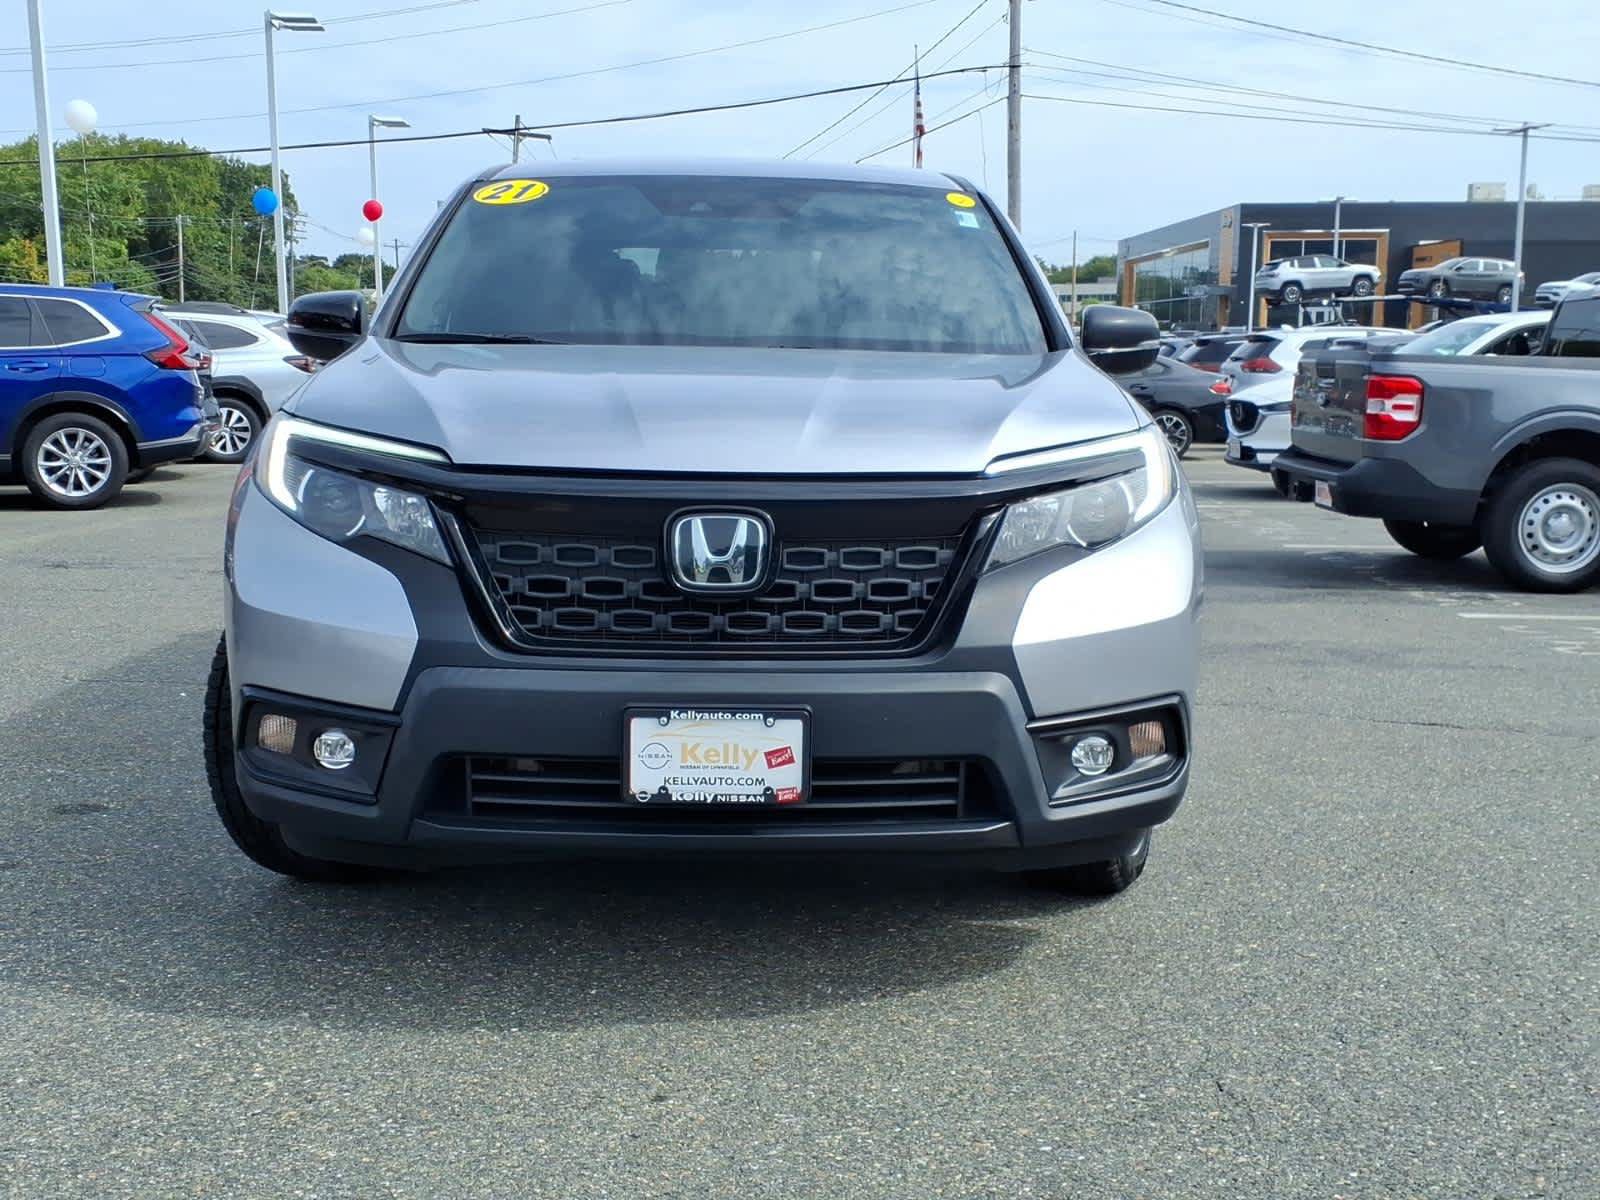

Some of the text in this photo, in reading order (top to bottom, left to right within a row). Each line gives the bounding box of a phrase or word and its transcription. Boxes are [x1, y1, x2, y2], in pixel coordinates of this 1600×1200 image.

[480, 183, 537, 201] 21
[670, 710, 764, 721] Kellyauto.com
[681, 742, 759, 771] Kelly
[663, 776, 766, 786] KELLYAUTO.COM
[717, 794, 765, 803] NISSAN
